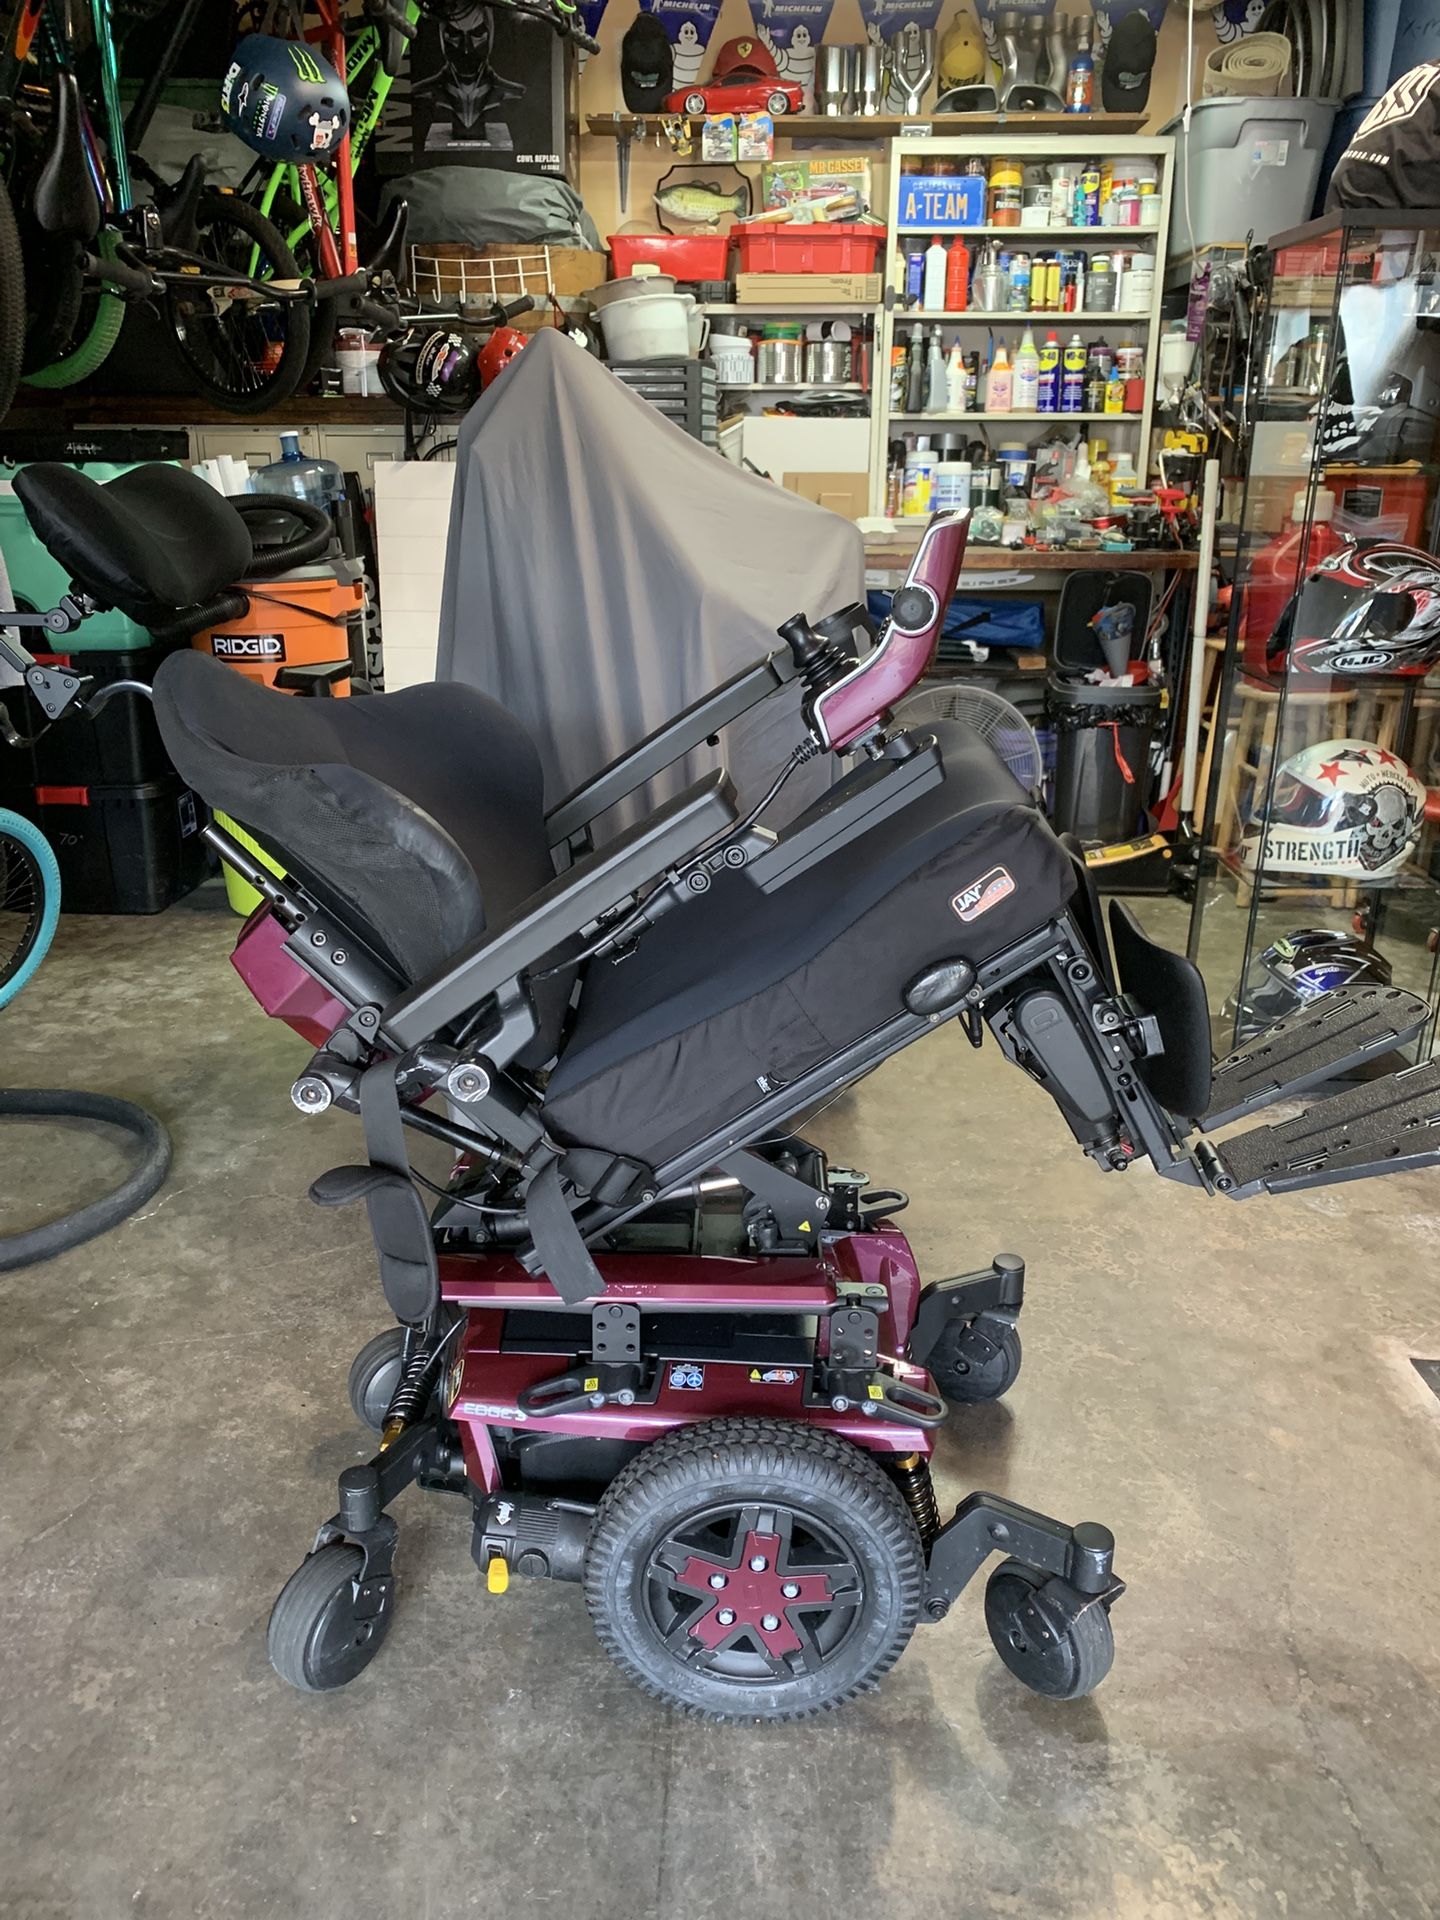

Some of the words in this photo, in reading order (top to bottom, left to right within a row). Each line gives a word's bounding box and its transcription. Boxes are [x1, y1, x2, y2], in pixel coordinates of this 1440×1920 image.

[663, 0, 711, 11] MICHELIN
[774, 4, 823, 13] MICHELIN
[885, 1, 934, 9] MICHELIN
[535, 154, 560, 163] REPLICA
[905, 192, 968, 220] A-TEAM
[213, 638, 282, 654] RIDGID
[1340, 655, 1382, 666] HJC
[1359, 772, 1376, 789] MOTO
[1264, 839, 1360, 862] STRENGTH
[957, 884, 982, 912] JAY
